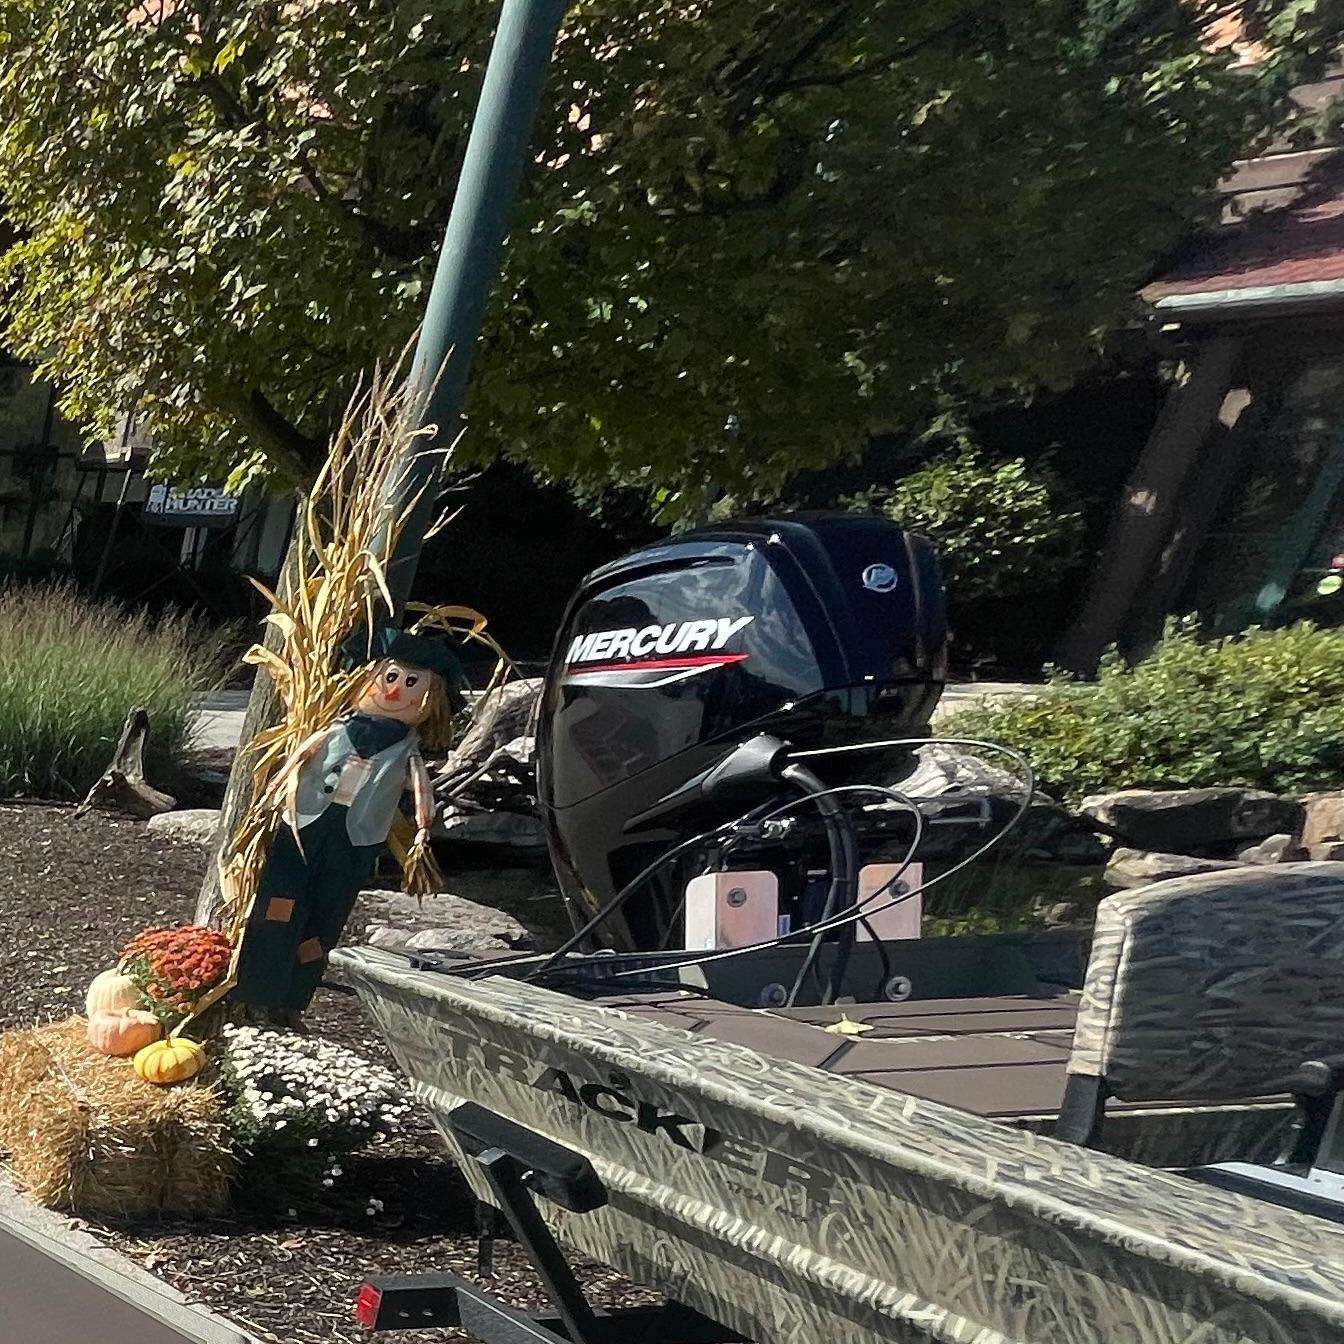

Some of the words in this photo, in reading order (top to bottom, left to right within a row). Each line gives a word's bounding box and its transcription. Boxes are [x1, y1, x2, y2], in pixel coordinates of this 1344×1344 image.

[166, 498, 238, 511] HUNTER
[567, 616, 754, 664] MERCURY
[440, 1025, 833, 1206] TRACKER
